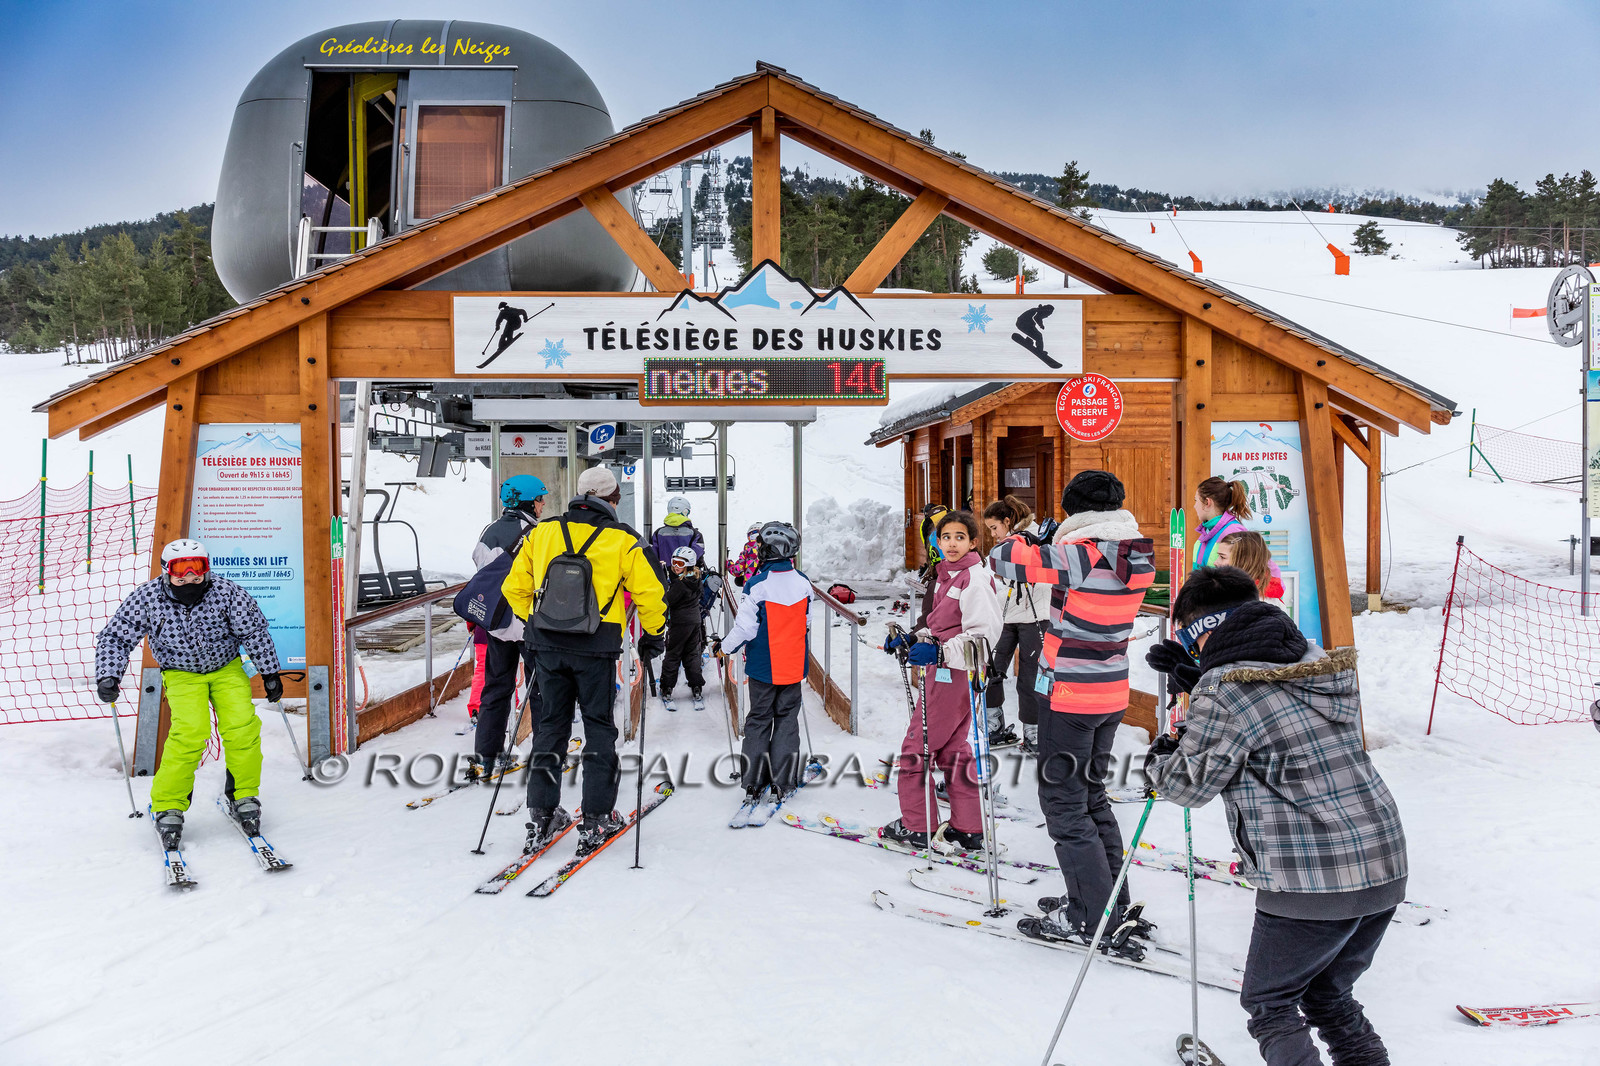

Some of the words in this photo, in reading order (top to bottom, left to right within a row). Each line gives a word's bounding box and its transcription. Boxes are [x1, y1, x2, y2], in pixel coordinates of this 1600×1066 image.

[320, 36, 414, 57] Gréolières
[420, 37, 446, 54] les
[452, 37, 511, 64] Neiges
[583, 321, 739, 351] TÉLÉSIÈGE
[753, 328, 804, 351] DES
[818, 327, 942, 351] HUSKIES
[1059, 386, 1072, 411] ECOLE
[1071, 379, 1082, 388] DU
[1072, 398, 1108, 406] PASSAGE
[1072, 408, 1108, 416] RESERVE
[1082, 418, 1097, 426] ESF
[1101, 418, 1115, 433] NEIGES
[202, 455, 247, 466] TÉLÉSIÈGE
[250, 457, 267, 466] DES
[1222, 452, 1242, 461] PLAN
[1245, 452, 1260, 460] DES
[1262, 452, 1288, 461] PISTES
[1172, 533, 1182, 548] 125
[213, 557, 250, 566] HUSKIES
[253, 557, 267, 566] SKI
[270, 557, 288, 566] LIFT
